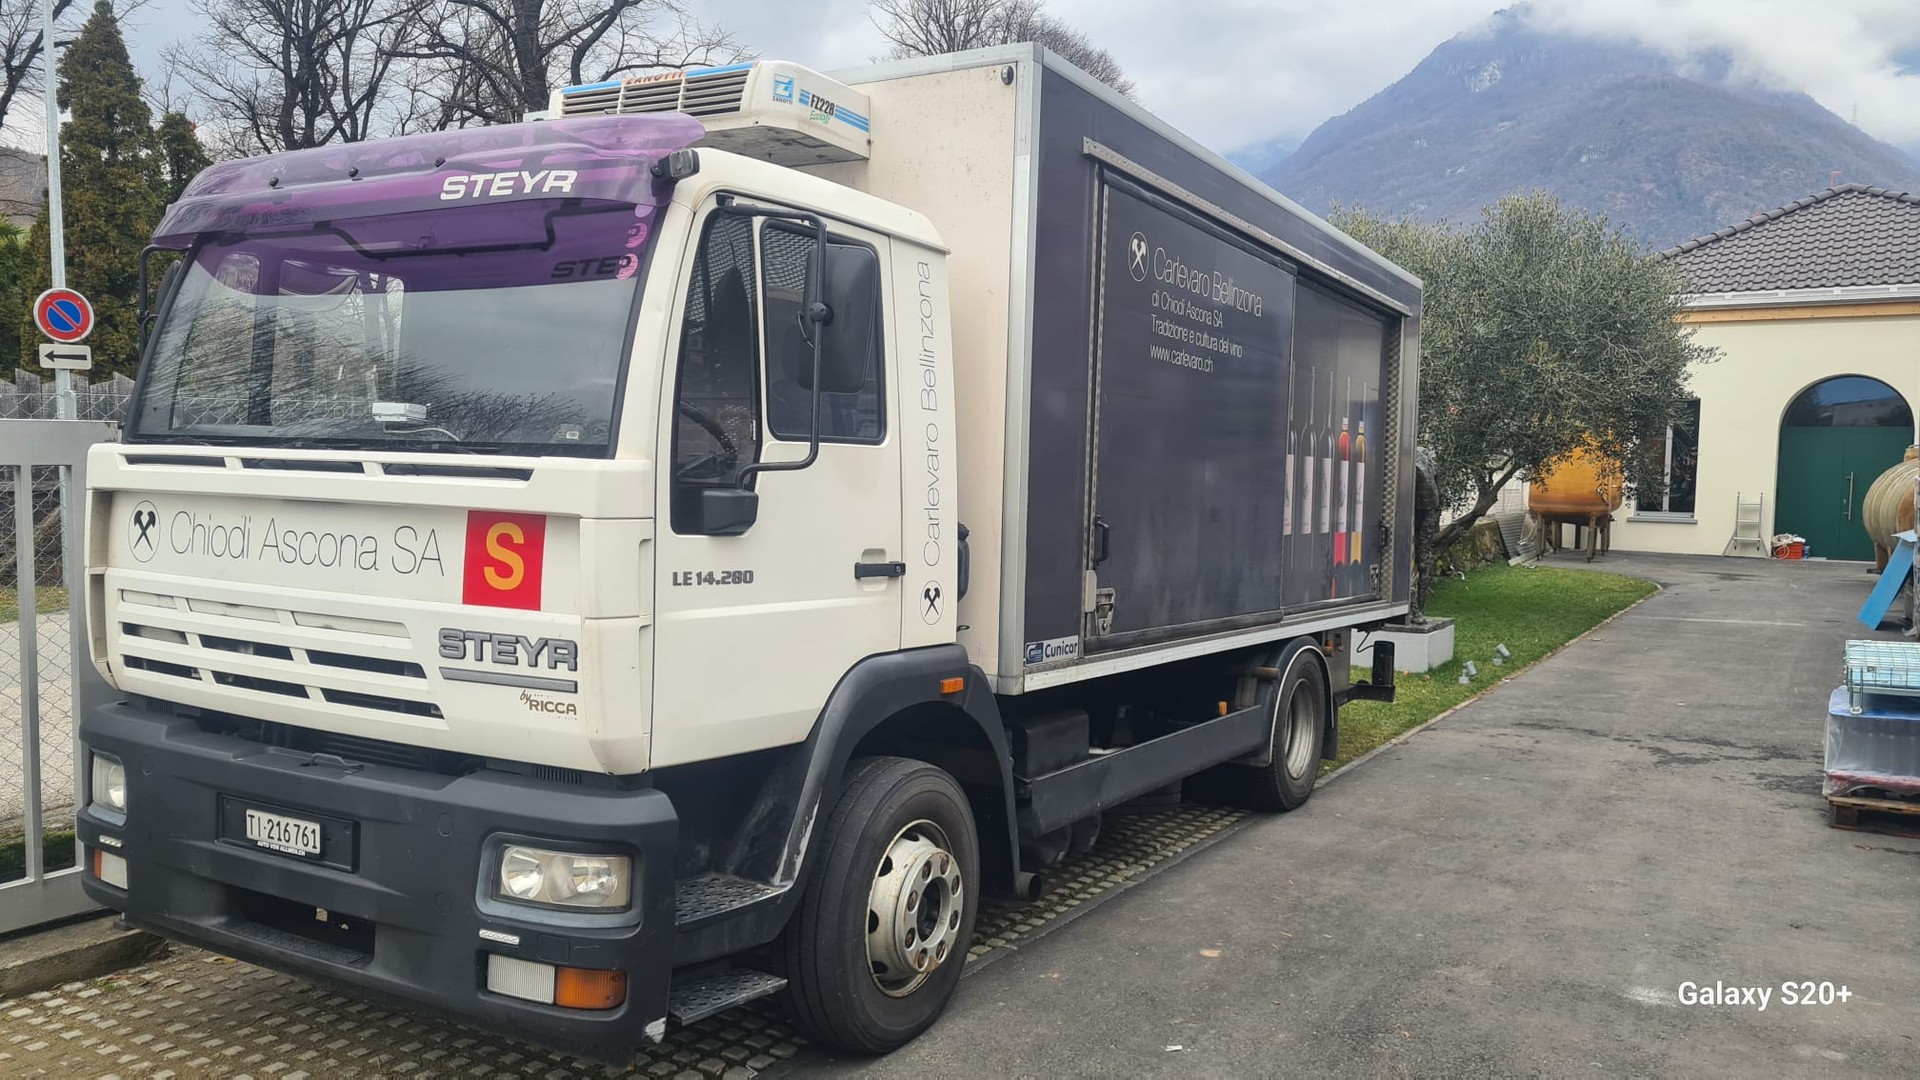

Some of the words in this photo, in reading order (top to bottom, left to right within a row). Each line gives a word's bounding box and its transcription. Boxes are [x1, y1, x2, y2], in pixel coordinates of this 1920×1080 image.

[810, 93, 835, 116] FZ228
[440, 170, 577, 200] STEYR
[1153, 247, 1211, 297] Carlevaro
[1212, 270, 1262, 317] Bellinzona
[1151, 289, 1160, 308] di
[1161, 291, 1185, 315] Chiodi
[1185, 300, 1212, 325] Ascona
[1212, 309, 1224, 328] SA
[916, 261, 938, 412] Bellinzona
[1150, 313, 1188, 342] Tradizione
[1189, 330, 1195, 344] e
[1195, 331, 1218, 351] cultura
[1218, 337, 1229, 354] del
[1229, 341, 1243, 358] vino
[1150, 344, 1214, 374] www.carlevaro.ch
[923, 423, 941, 567] Carlevaro
[170, 510, 252, 560] Chiodi
[258, 517, 379, 571] Ascona
[391, 525, 445, 577] SA
[483, 521, 525, 591] S
[672, 571, 692, 587] LE
[695, 569, 754, 586] 14.280
[438, 627, 578, 672] STEYR
[1044, 640, 1078, 658] Cunicar
[519, 689, 532, 705] by
[529, 699, 577, 716] RICCA
